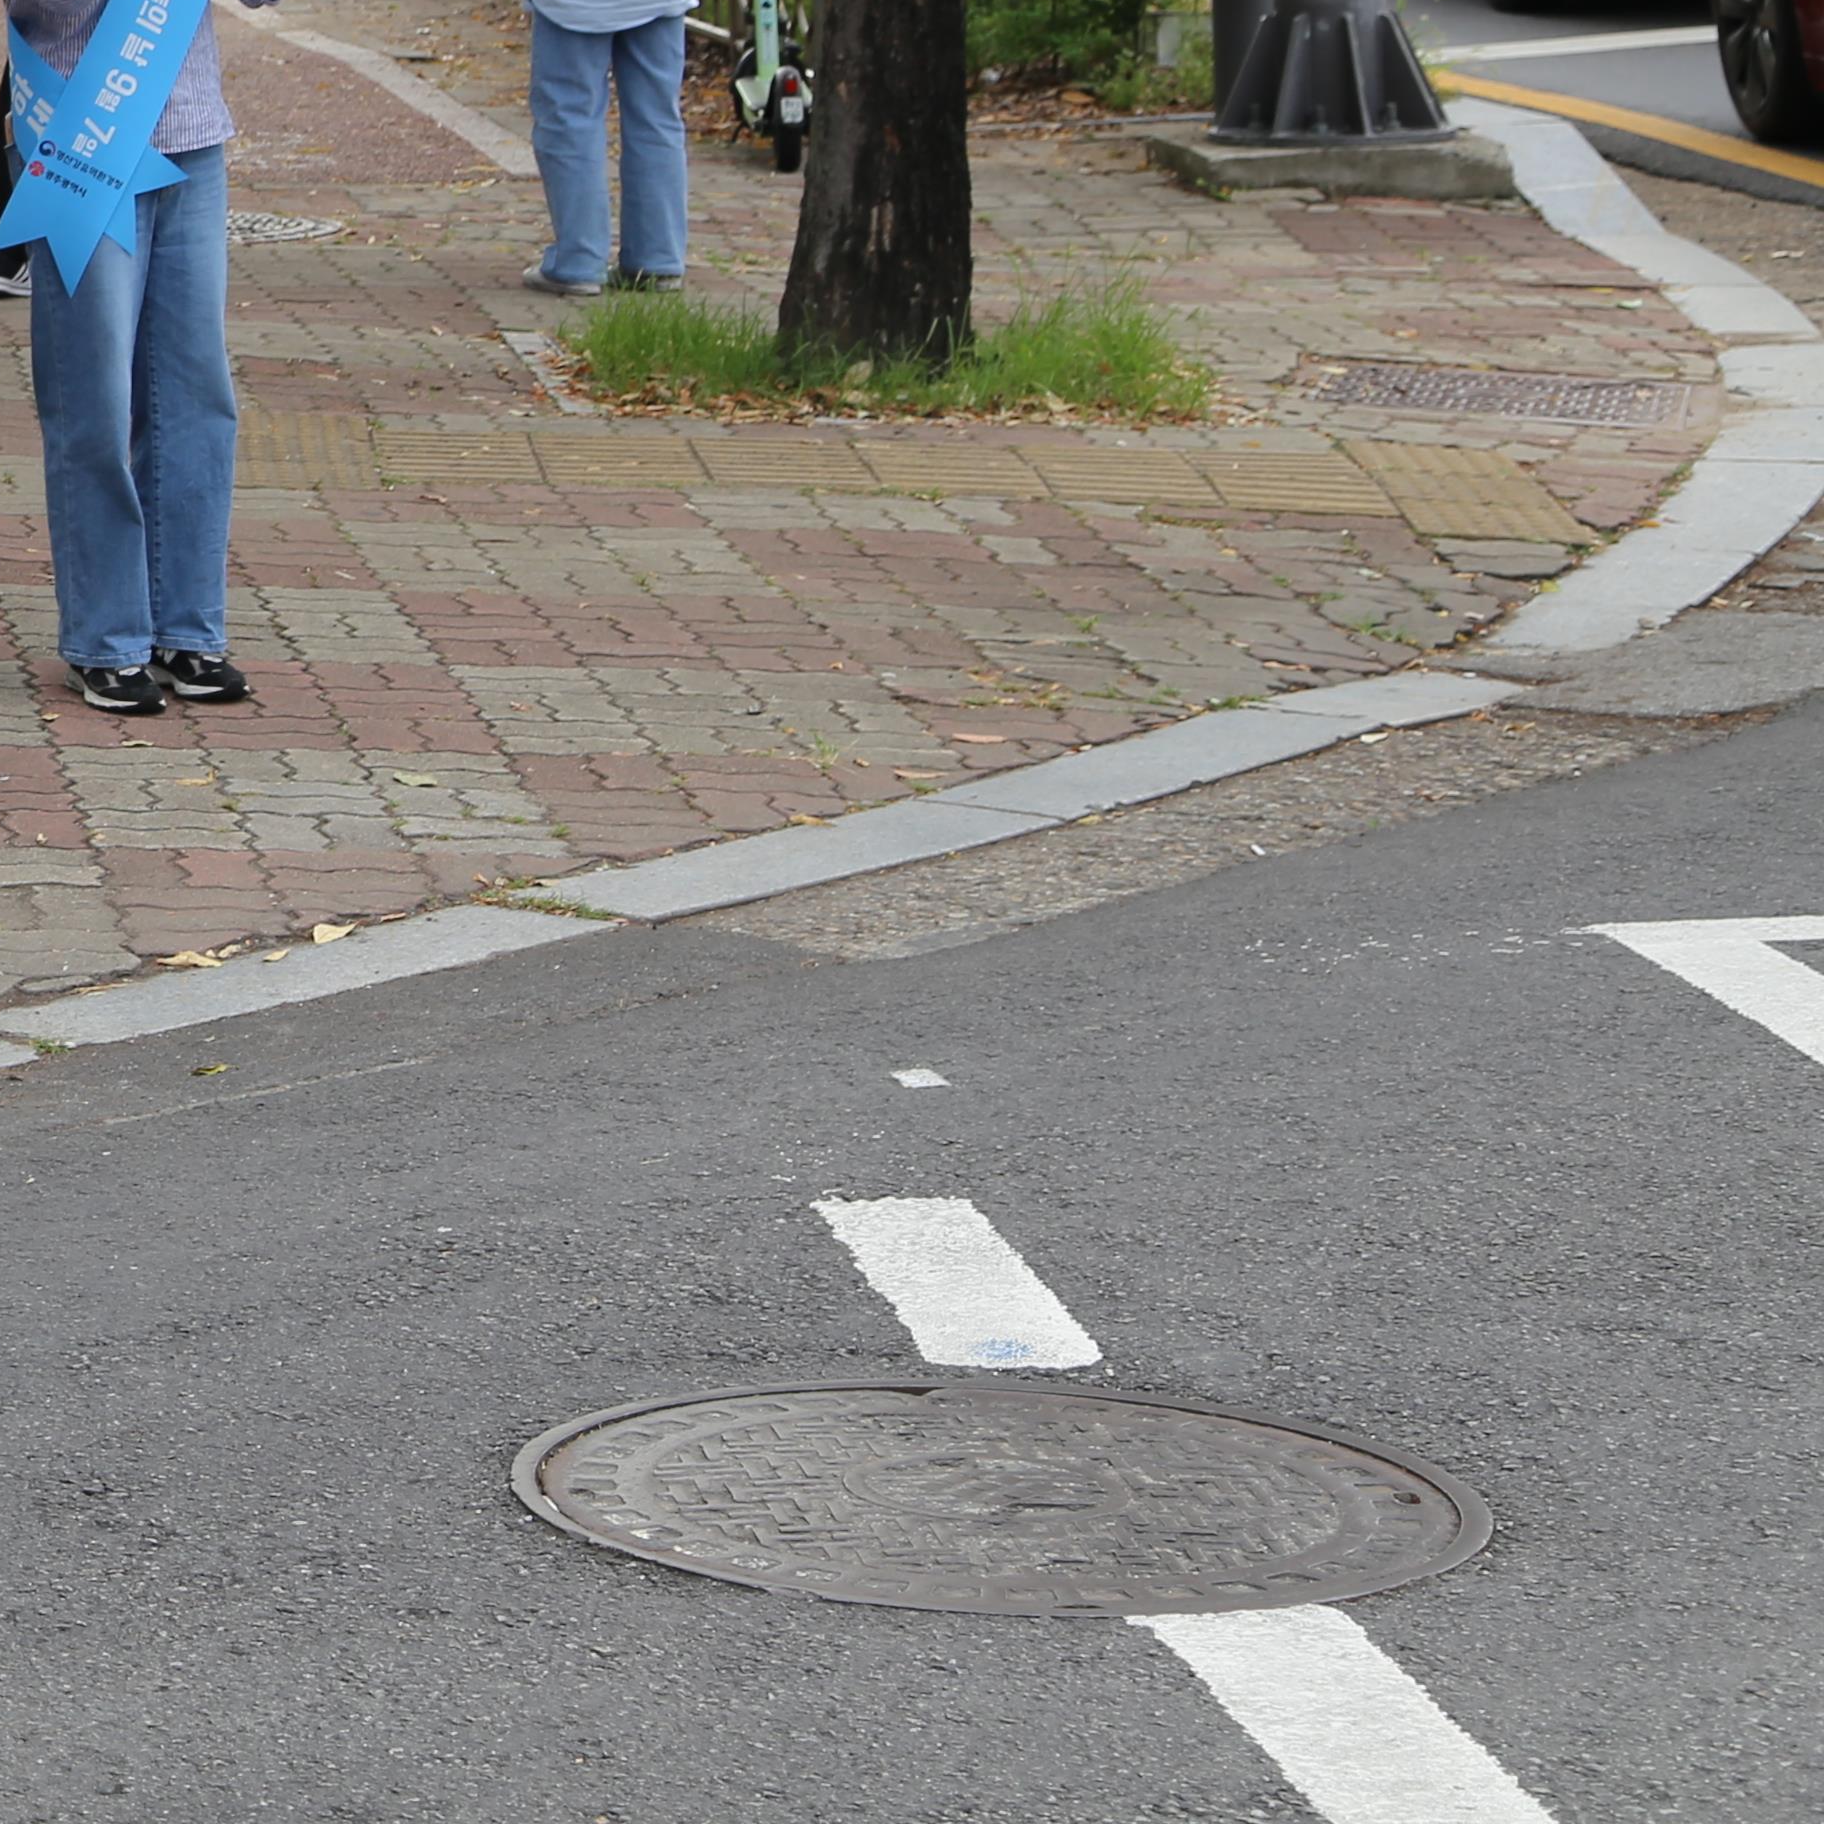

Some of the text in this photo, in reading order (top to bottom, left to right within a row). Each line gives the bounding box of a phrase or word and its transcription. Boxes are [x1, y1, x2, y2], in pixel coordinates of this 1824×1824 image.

[120, 32, 154, 67] 날
[94, 67, 138, 113] 9월
[71, 117, 117, 159] 7일
